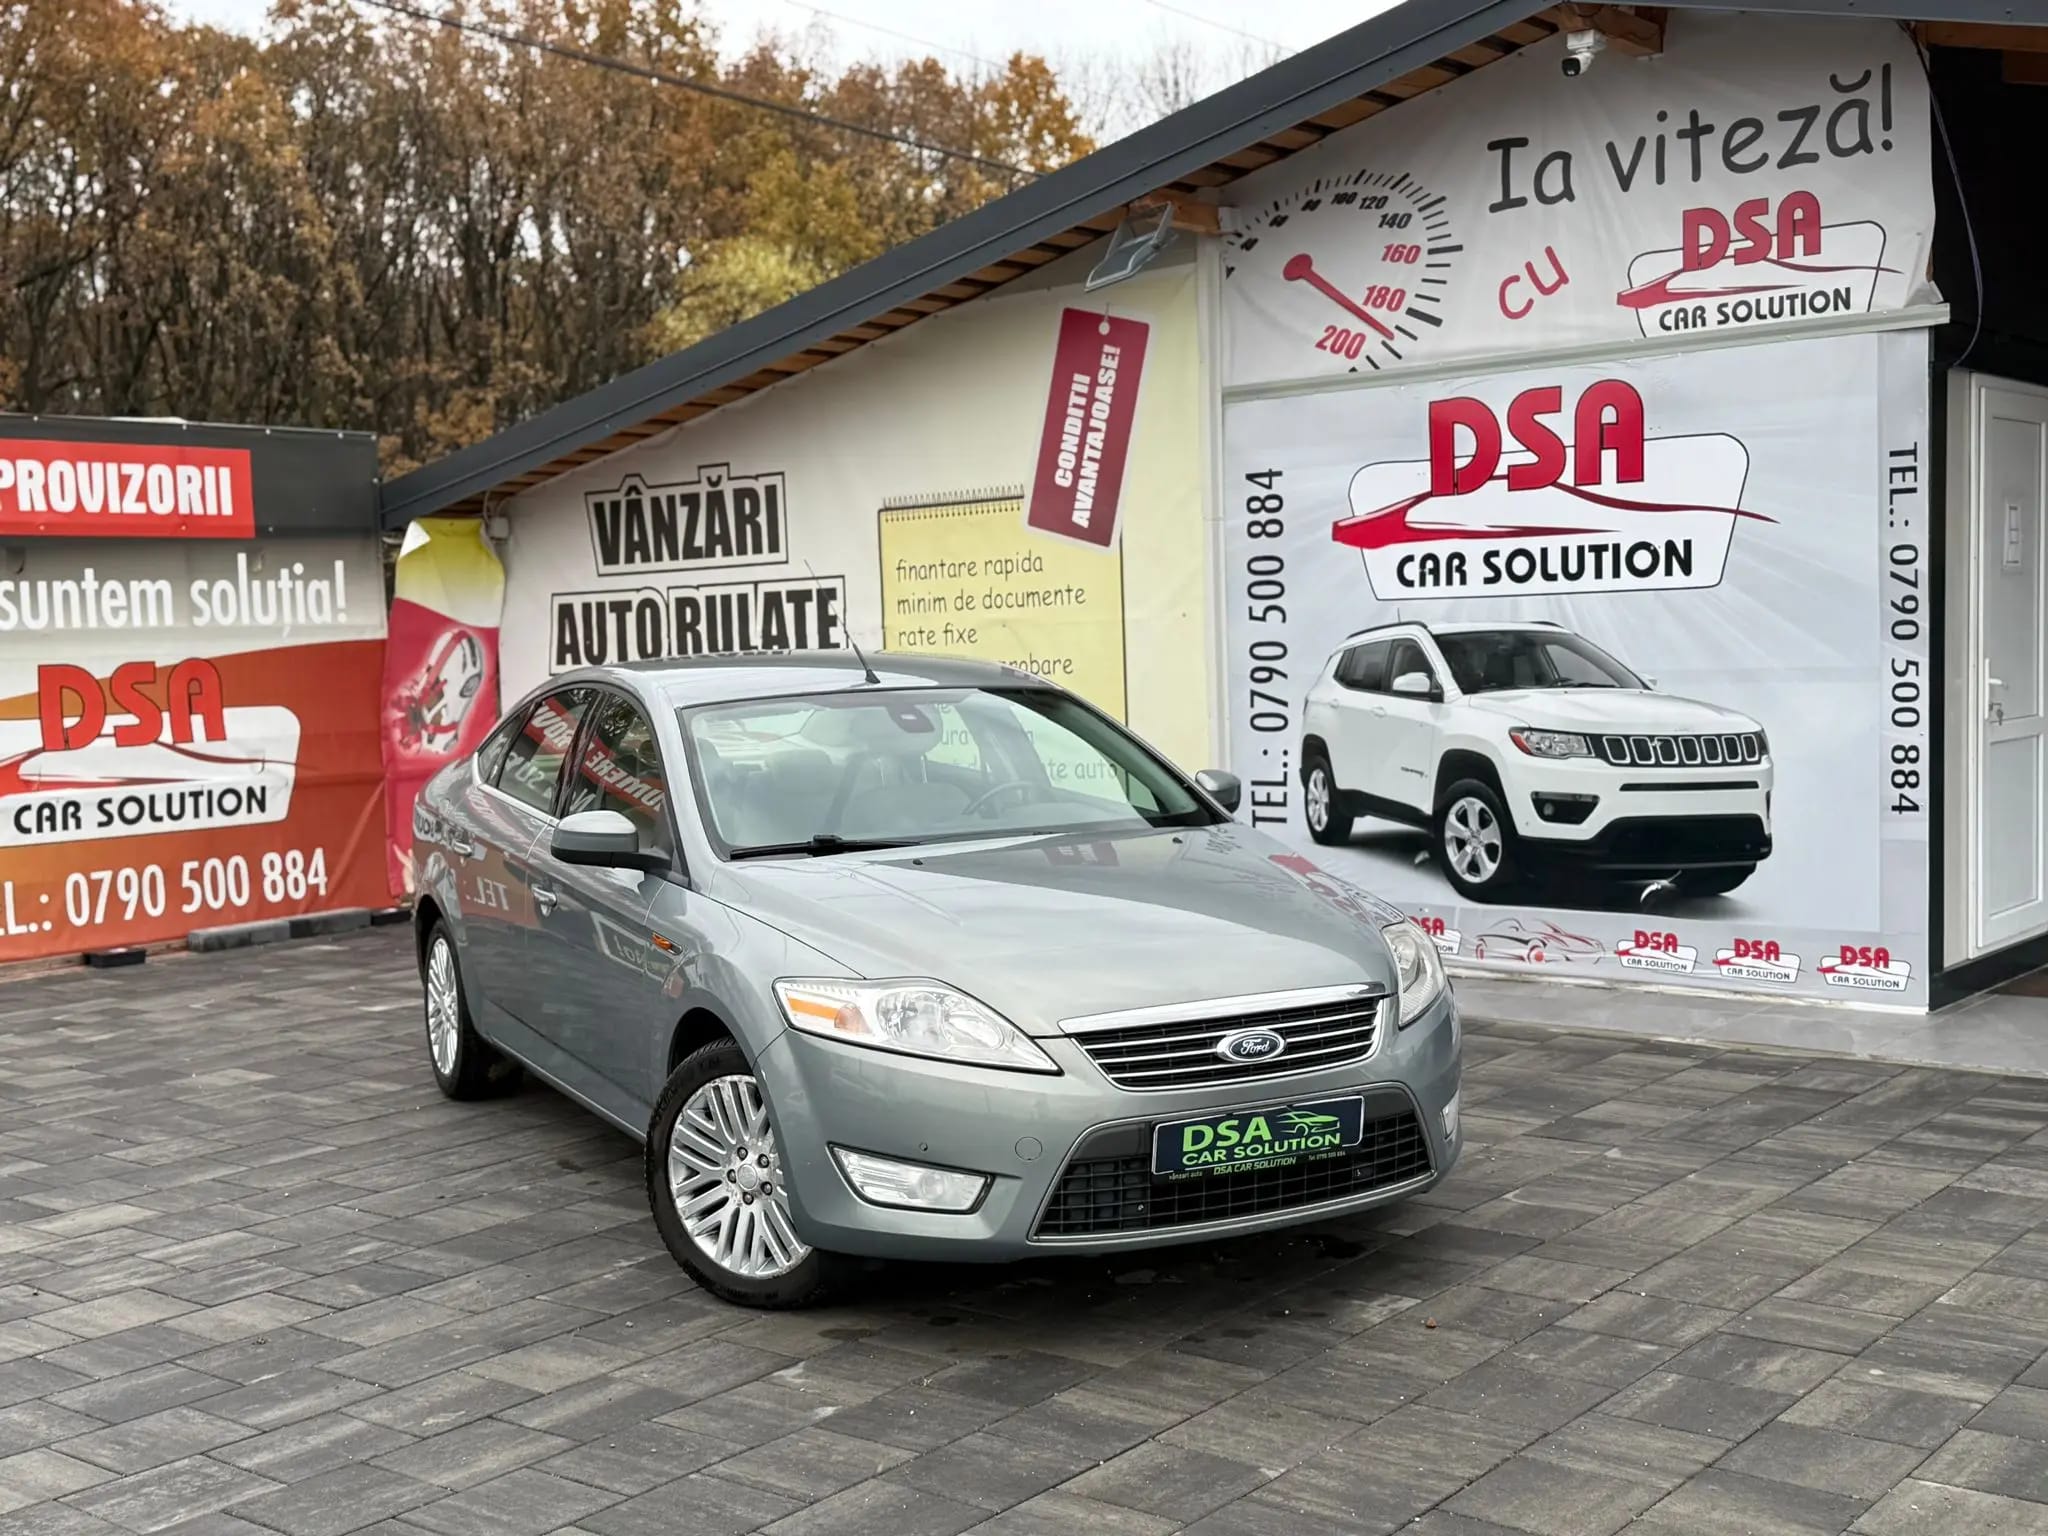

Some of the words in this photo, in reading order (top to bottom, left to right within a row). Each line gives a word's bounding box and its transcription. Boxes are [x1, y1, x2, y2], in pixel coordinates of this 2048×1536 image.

[1487, 137, 1575, 213] Ia
[1605, 63, 1893, 192] viteză!
[1359, 196, 1389, 210] 120
[1378, 213, 1412, 229] 140
[1381, 243, 1421, 264] 160
[1683, 191, 1821, 272] DSA
[1362, 285, 1406, 312] 180
[1499, 246, 1569, 319] cu
[1659, 307, 1706, 331] CAR
[1717, 286, 1851, 325] SOLUTION
[1315, 325, 1366, 360] 200
[1055, 373, 1091, 487] CONDITII
[1072, 344, 1121, 528] AVANTAJOASE!
[1428, 379, 1644, 496] DSA
[1245, 469, 1283, 539] 884
[1889, 442, 1918, 528] TEL.:
[593, 474, 781, 566] VÂNZĂRI
[896, 559, 977, 583] finantare
[984, 550, 1043, 581] rapida
[1397, 552, 1467, 587] CAR
[1483, 539, 1692, 585] SOLUTION
[0, 568, 174, 630] suntem
[897, 592, 947, 614] minim
[954, 589, 976, 611] de
[982, 584, 1087, 609] documente
[1247, 555, 1287, 623] 500
[1889, 544, 1919, 641] 0790
[556, 597, 663, 666] AUTO
[675, 587, 841, 655] RULATE
[899, 626, 936, 646] rate
[944, 622, 978, 647] fixe
[37, 657, 227, 752] DSA
[1249, 641, 1288, 732] 0790
[1891, 658, 1920, 728] 500
[1251, 749, 1288, 828] TEL.:
[1890, 744, 1920, 814] 884
[14, 800, 81, 834] CAR
[96, 786, 266, 827] SOLUTION
[65, 864, 166, 927] 0790
[181, 855, 250, 913] 500
[261, 847, 327, 903] 884
[1626, 958, 1643, 967] CAR
[1645, 959, 1687, 972] SOLUTION
[1634, 929, 1678, 953] DSA
[1734, 938, 1780, 962] DSA
[1840, 945, 1890, 969] DSA
[1727, 967, 1744, 977] CAR
[1746, 968, 1790, 981] SOLUTION
[1832, 975, 1849, 984] CAR
[1852, 976, 1900, 988] SOLUTION
[1240, 1038, 1270, 1054] Ford
[1182, 1116, 1272, 1152] DSA
[1182, 1150, 1227, 1165] CAR
[1234, 1133, 1341, 1157] SOLUTION
[1213, 1165, 1233, 1176] DSA
[1234, 1162, 1252, 1173] CAR
[1254, 1157, 1296, 1170] SOLUTION
